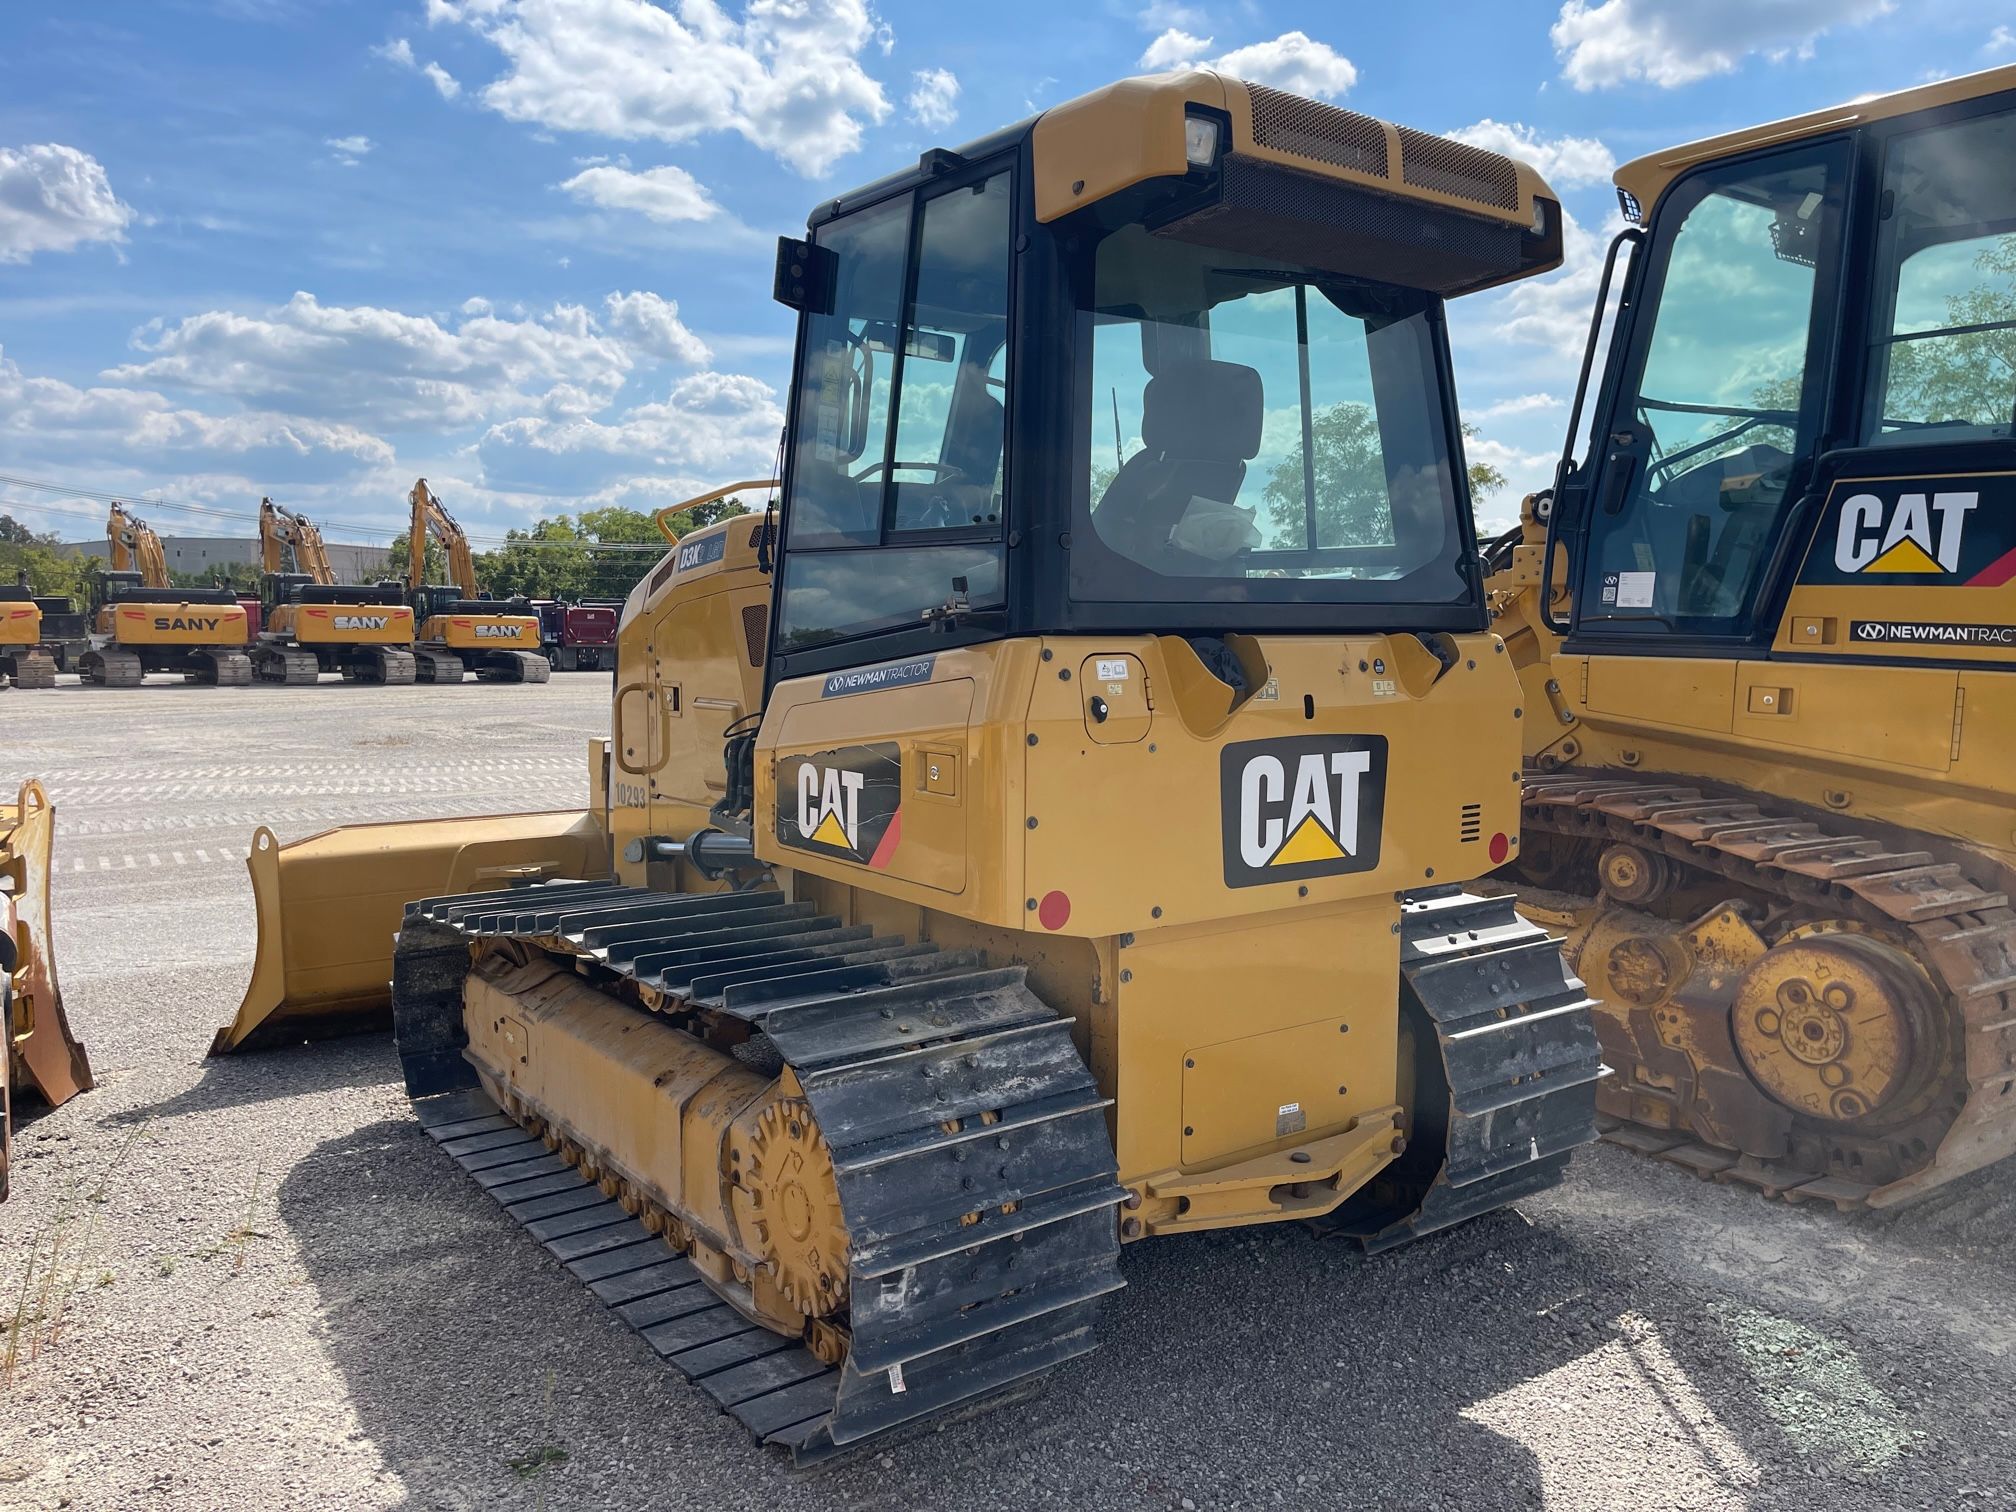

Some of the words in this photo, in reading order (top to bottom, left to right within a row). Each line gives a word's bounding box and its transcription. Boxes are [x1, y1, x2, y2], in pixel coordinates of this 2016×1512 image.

[1835, 492, 1979, 573] CAT
[154, 618, 220, 631] SANY
[334, 616, 389, 630] SANY
[475, 625, 523, 637] SANY
[844, 662, 930, 688] NEWMANTRACTOR
[615, 782, 646, 810] 10293
[797, 762, 864, 851] CAT
[1240, 750, 1371, 868] CAT
